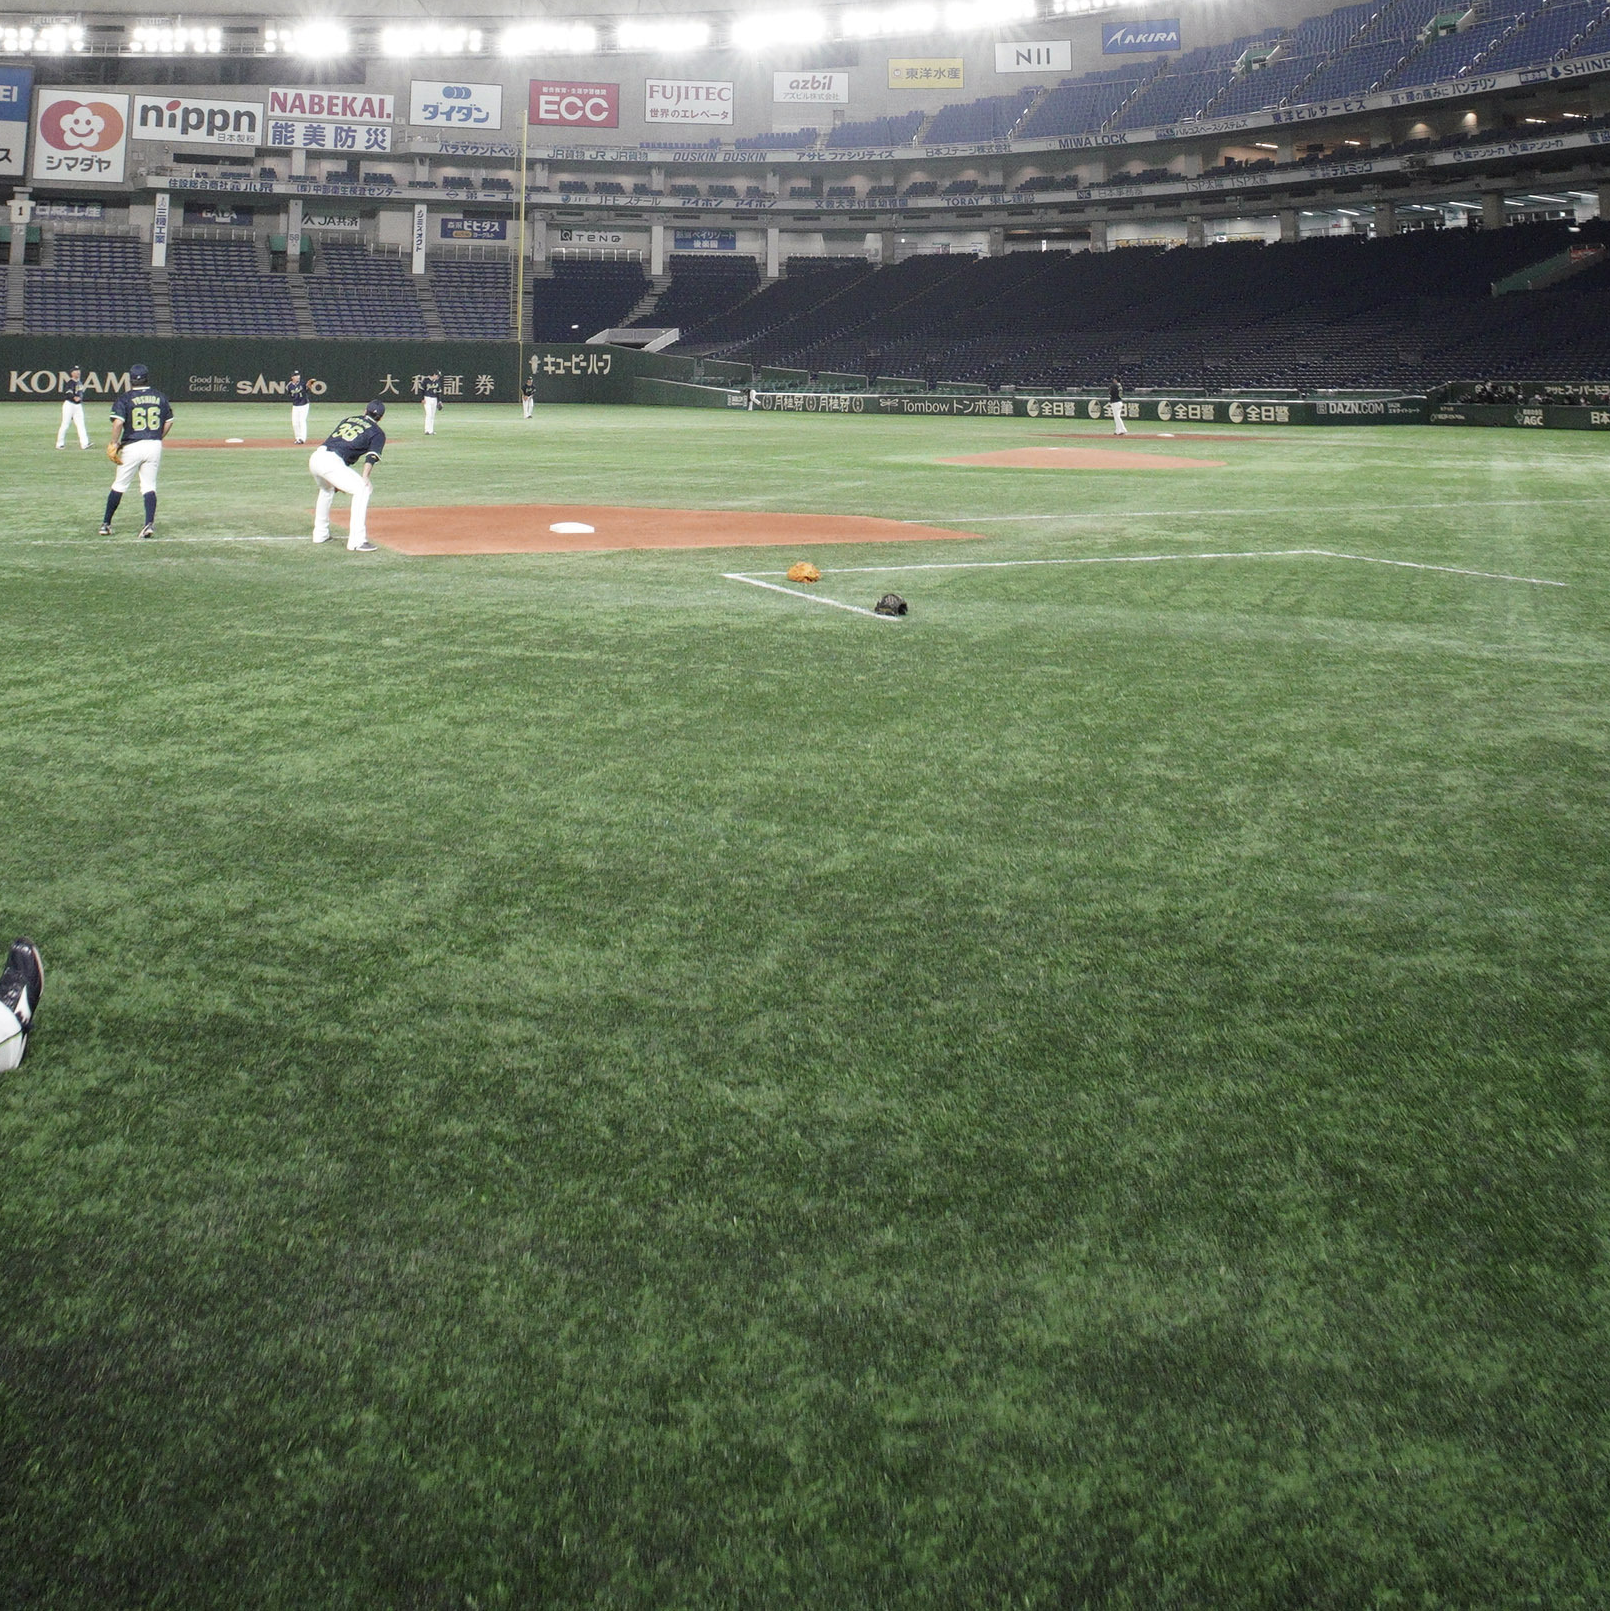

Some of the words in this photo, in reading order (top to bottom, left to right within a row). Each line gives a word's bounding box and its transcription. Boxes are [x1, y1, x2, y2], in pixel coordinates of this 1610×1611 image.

[1124, 31, 1178, 46] AKIRA
[905, 67, 960, 80] 東洋水産
[789, 75, 833, 91] azbil
[648, 84, 731, 104] FUJITEC
[782, 92, 840, 101] アズビル株式会社
[421, 102, 490, 124] ダイダン
[538, 95, 610, 123] ECC
[649, 107, 730, 121] 世界のエレベータ
[1272, 100, 1366, 124] 東洋ビルサービス
[140, 98, 257, 136] nippn
[217, 132, 255, 144] 日本製粉
[271, 121, 388, 152] 能美防災
[1058, 137, 1093, 150] MIWA
[1095, 134, 1127, 146] LOCK
[547, 149, 585, 160] JR貨物
[589, 150, 606, 160] JR
[610, 150, 648, 161] JR貨物
[672, 151, 717, 161] DUSKIN
[722, 151, 767, 162] DUSKIN
[924, 144, 1012, 157] 日本ステージ株式会社
[45, 154, 111, 173] シマダヤ
[168, 177, 228, 190] 住設総合商社
[598, 195, 620, 205] JFE
[623, 196, 662, 206] スチール
[680, 197, 722, 208] アイホン
[734, 197, 777, 208] アイホン
[18, 206, 24, 216] 1
[317, 215, 359, 227] JA共済
[543, 354, 611, 375] キューピーハーフ
[189, 375, 212, 384] Good
[189, 384, 212, 393] Good
[774, 395, 804, 412] 月桂冠
[819, 395, 850, 413] 月桂冠
[901, 399, 949, 413] Tombow
[953, 399, 1014, 415] トンボ鉛筆
[1329, 402, 1385, 414] DAZN.COM
[131, 407, 161, 431] 66
[1040, 402, 1076, 417] 全日警
[1173, 404, 1215, 421] 全日警
[1246, 406, 1290, 423] 全日警
[1523, 416, 1544, 426] AGC
[332, 423, 365, 442] 36
